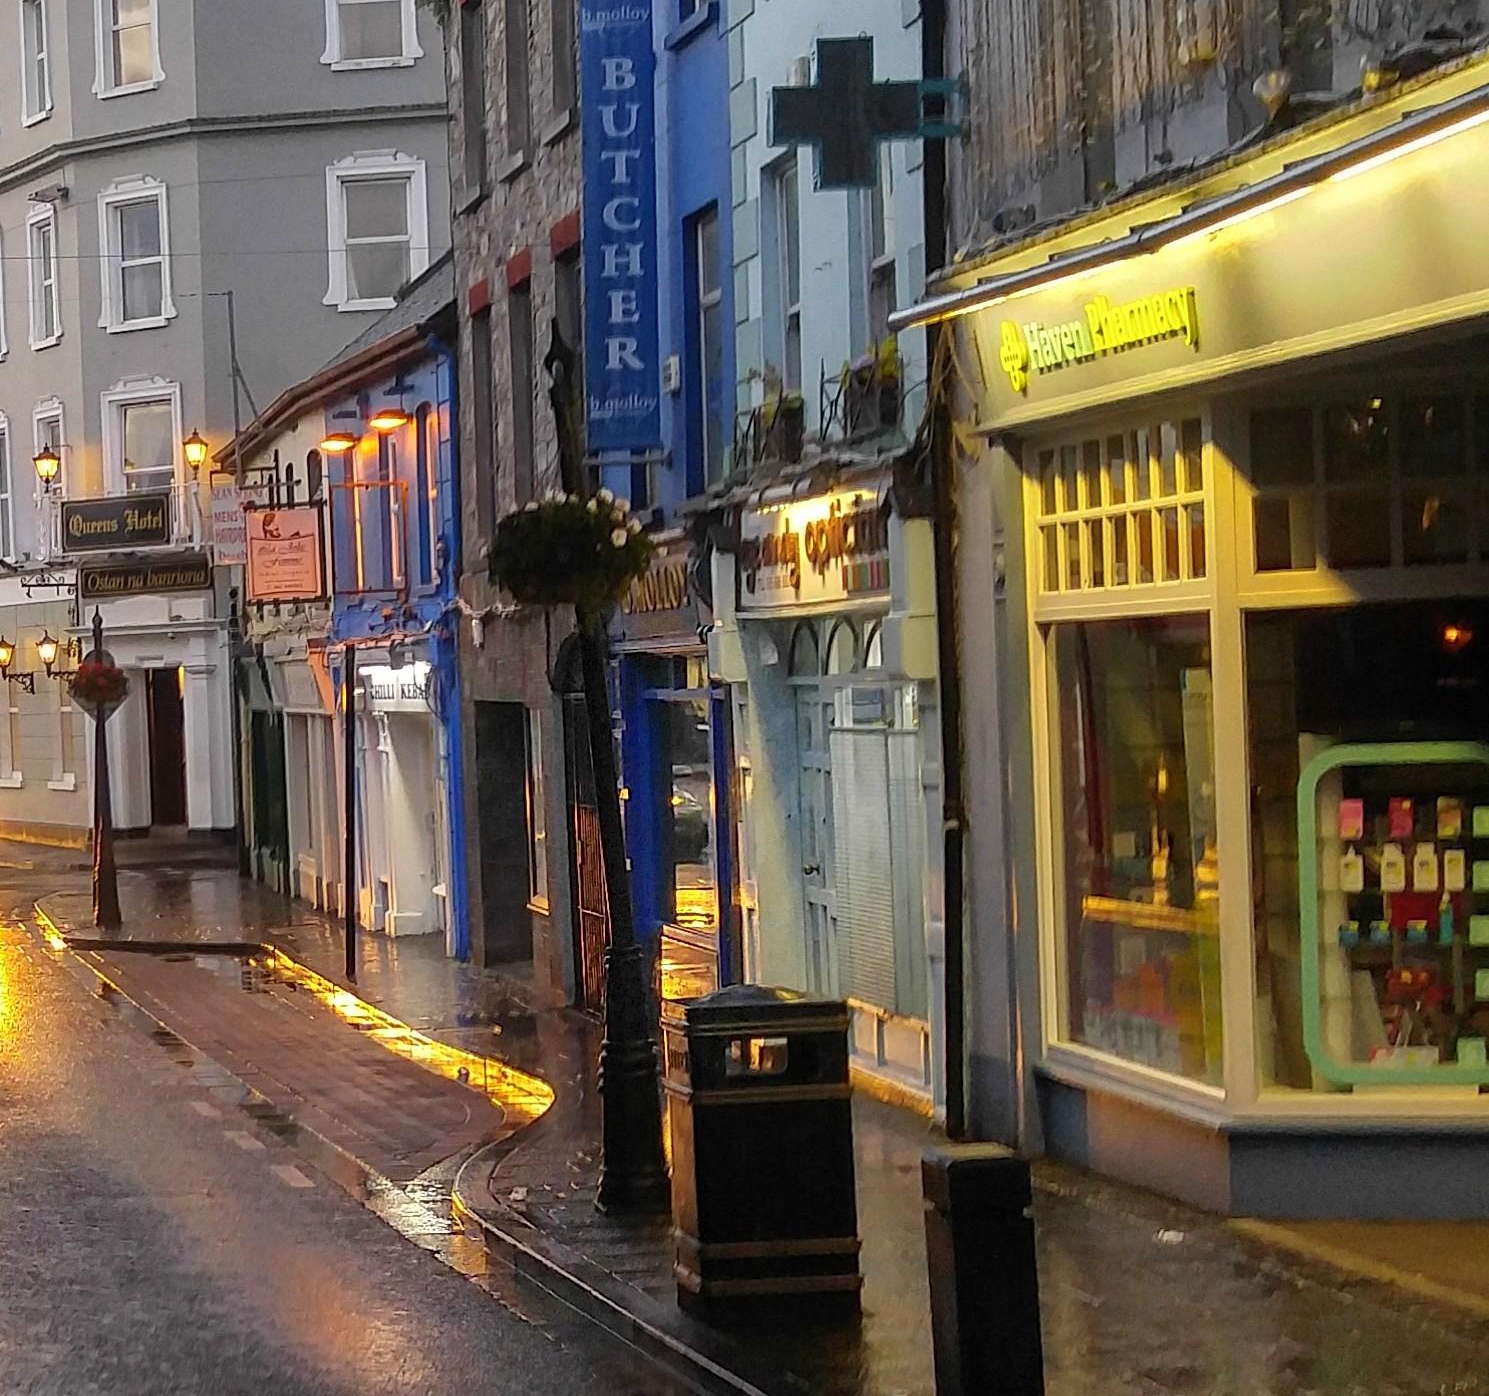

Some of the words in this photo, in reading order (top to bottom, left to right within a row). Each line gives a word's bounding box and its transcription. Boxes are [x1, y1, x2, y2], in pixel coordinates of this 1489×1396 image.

[599, 57, 645, 371] BUTCHER
[1023, 320, 1093, 371] Haven
[1085, 286, 1196, 353] Pharmacy
[68, 513, 119, 538] Queens
[123, 506, 163, 538] Hotel
